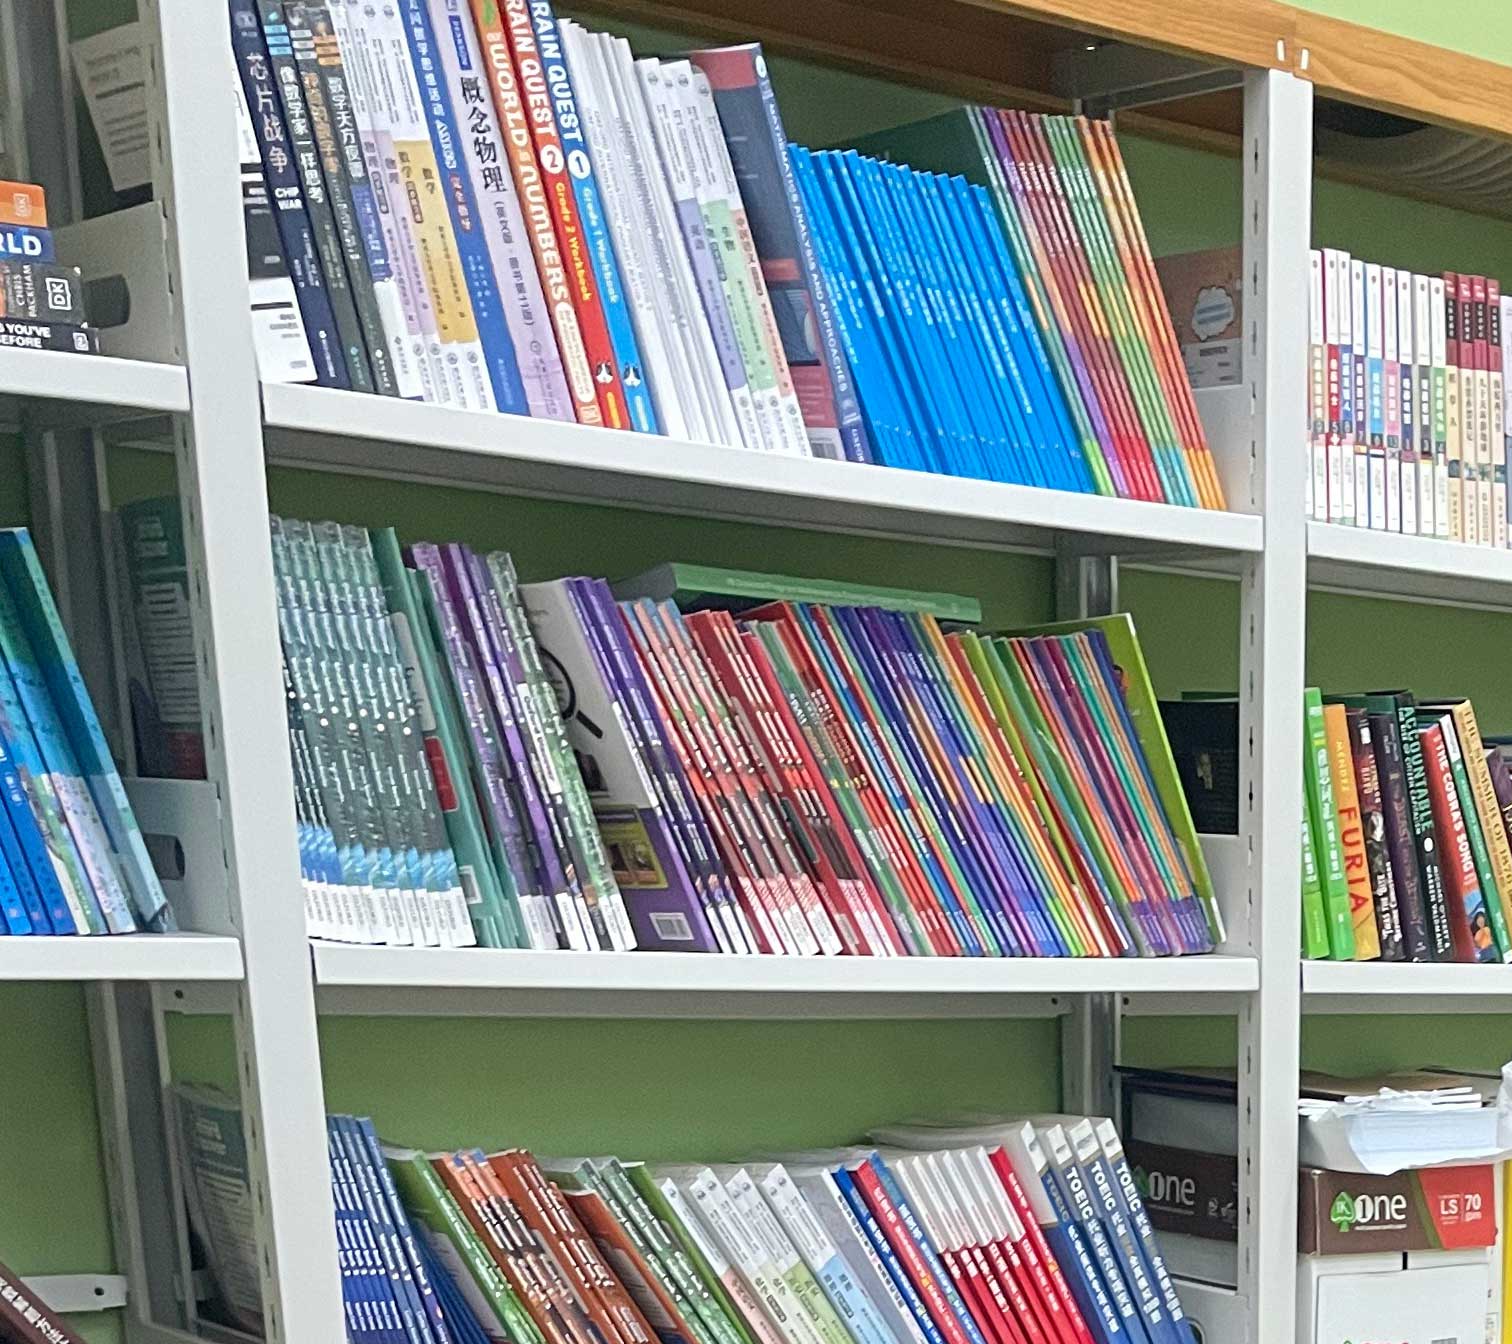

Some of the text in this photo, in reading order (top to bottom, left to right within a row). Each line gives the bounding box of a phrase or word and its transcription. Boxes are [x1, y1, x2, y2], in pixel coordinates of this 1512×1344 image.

[247, 52, 287, 173] 芯片战争
[461, 77, 507, 193] 概念物理
[521, 61, 556, 137] QUEST
[546, 151, 558, 168] 2
[548, 67, 582, 147] QUEST
[275, 186, 299, 198] CHIP
[278, 199, 302, 210] WAR
[489, 42, 569, 301] WORLD NUMBERS
[555, 182, 572, 222] Grade
[568, 236, 592, 301] Workbook
[582, 187, 618, 304] Grade Workbook
[764, 102, 849, 393] MATHEMATICS ANALYSIS AND APPROACHES
[14, 275, 25, 306] CHRIS
[24, 264, 37, 317] PACKHAM
[52, 282, 66, 305] DK
[7, 323, 51, 338] YOU'VE
[1402, 706, 1434, 832] ACCOUNTABLE
[1434, 745, 1473, 871] THE COBRA'S SONG
[1338, 806, 1369, 914] FURIA
[1063, 1166, 1094, 1220] TOEIC
[1088, 1160, 1117, 1211] TOEIC
[1113, 1162, 1142, 1212] TOEIC
[1440, 1200, 1458, 1214] LS
[1465, 1194, 1481, 1211] 70
